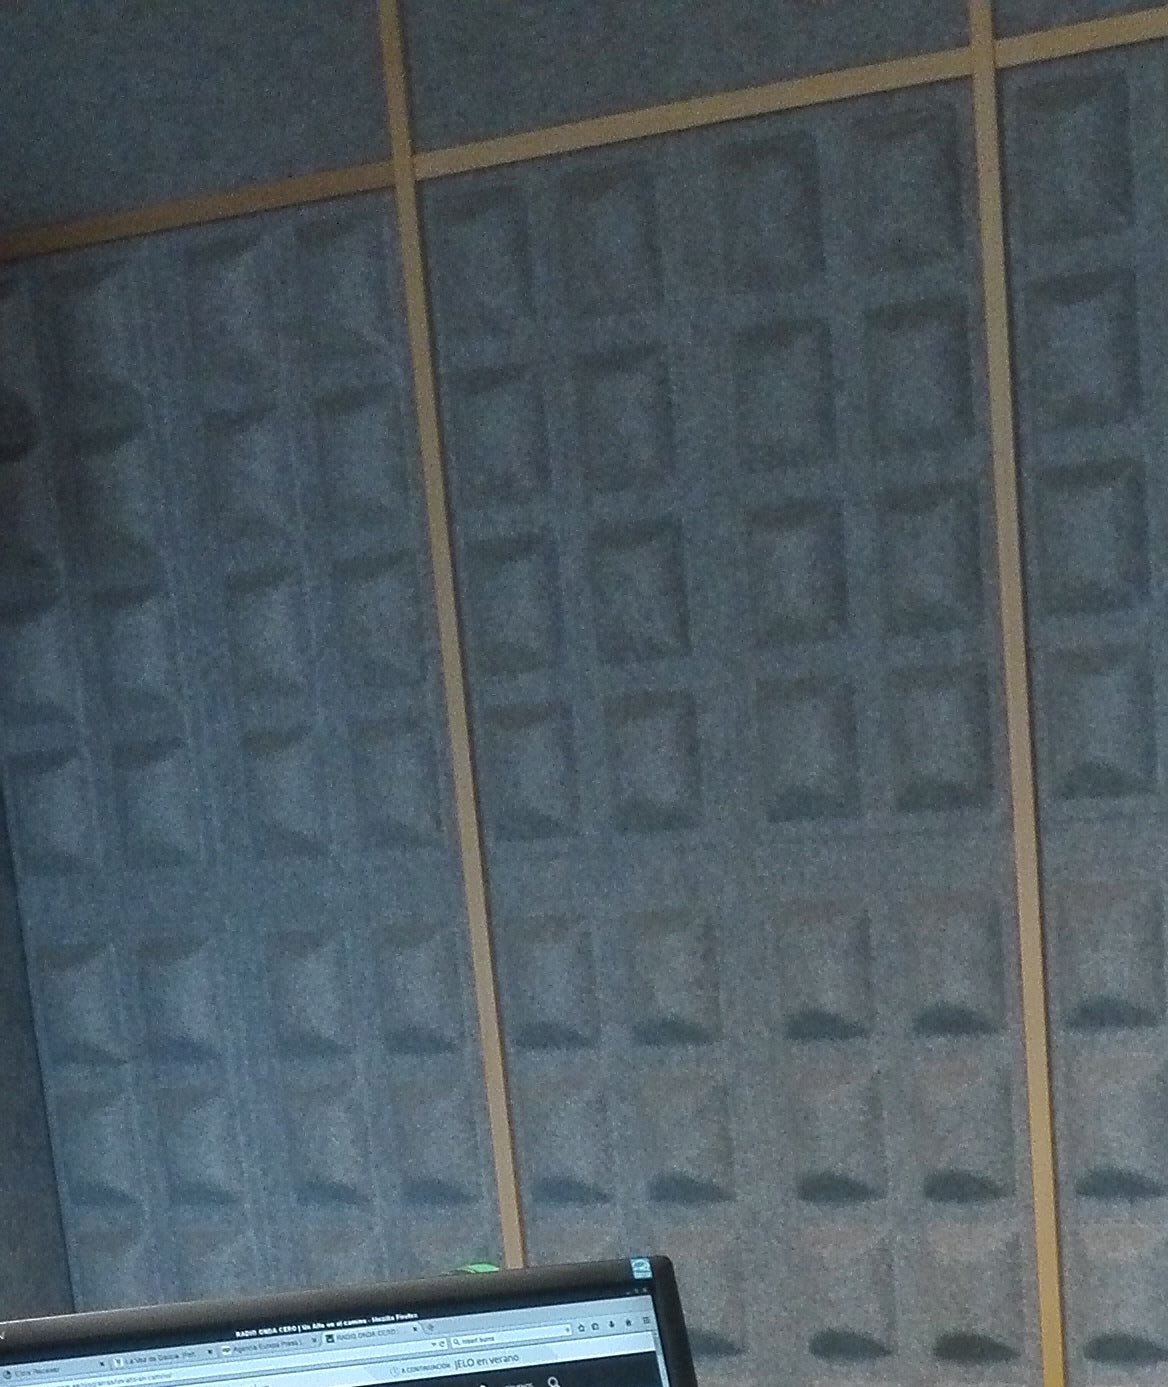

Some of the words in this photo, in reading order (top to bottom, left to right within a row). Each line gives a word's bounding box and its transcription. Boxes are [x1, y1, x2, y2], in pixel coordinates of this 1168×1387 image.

[236, 1329, 257, 1338] RADIO
[258, 1326, 278, 1336] ONDA
[279, 1324, 296, 1334] CERO
[455, 1354, 475, 1370] JELO
[476, 1355, 488, 1366] en
[490, 1354, 519, 1366] verano
